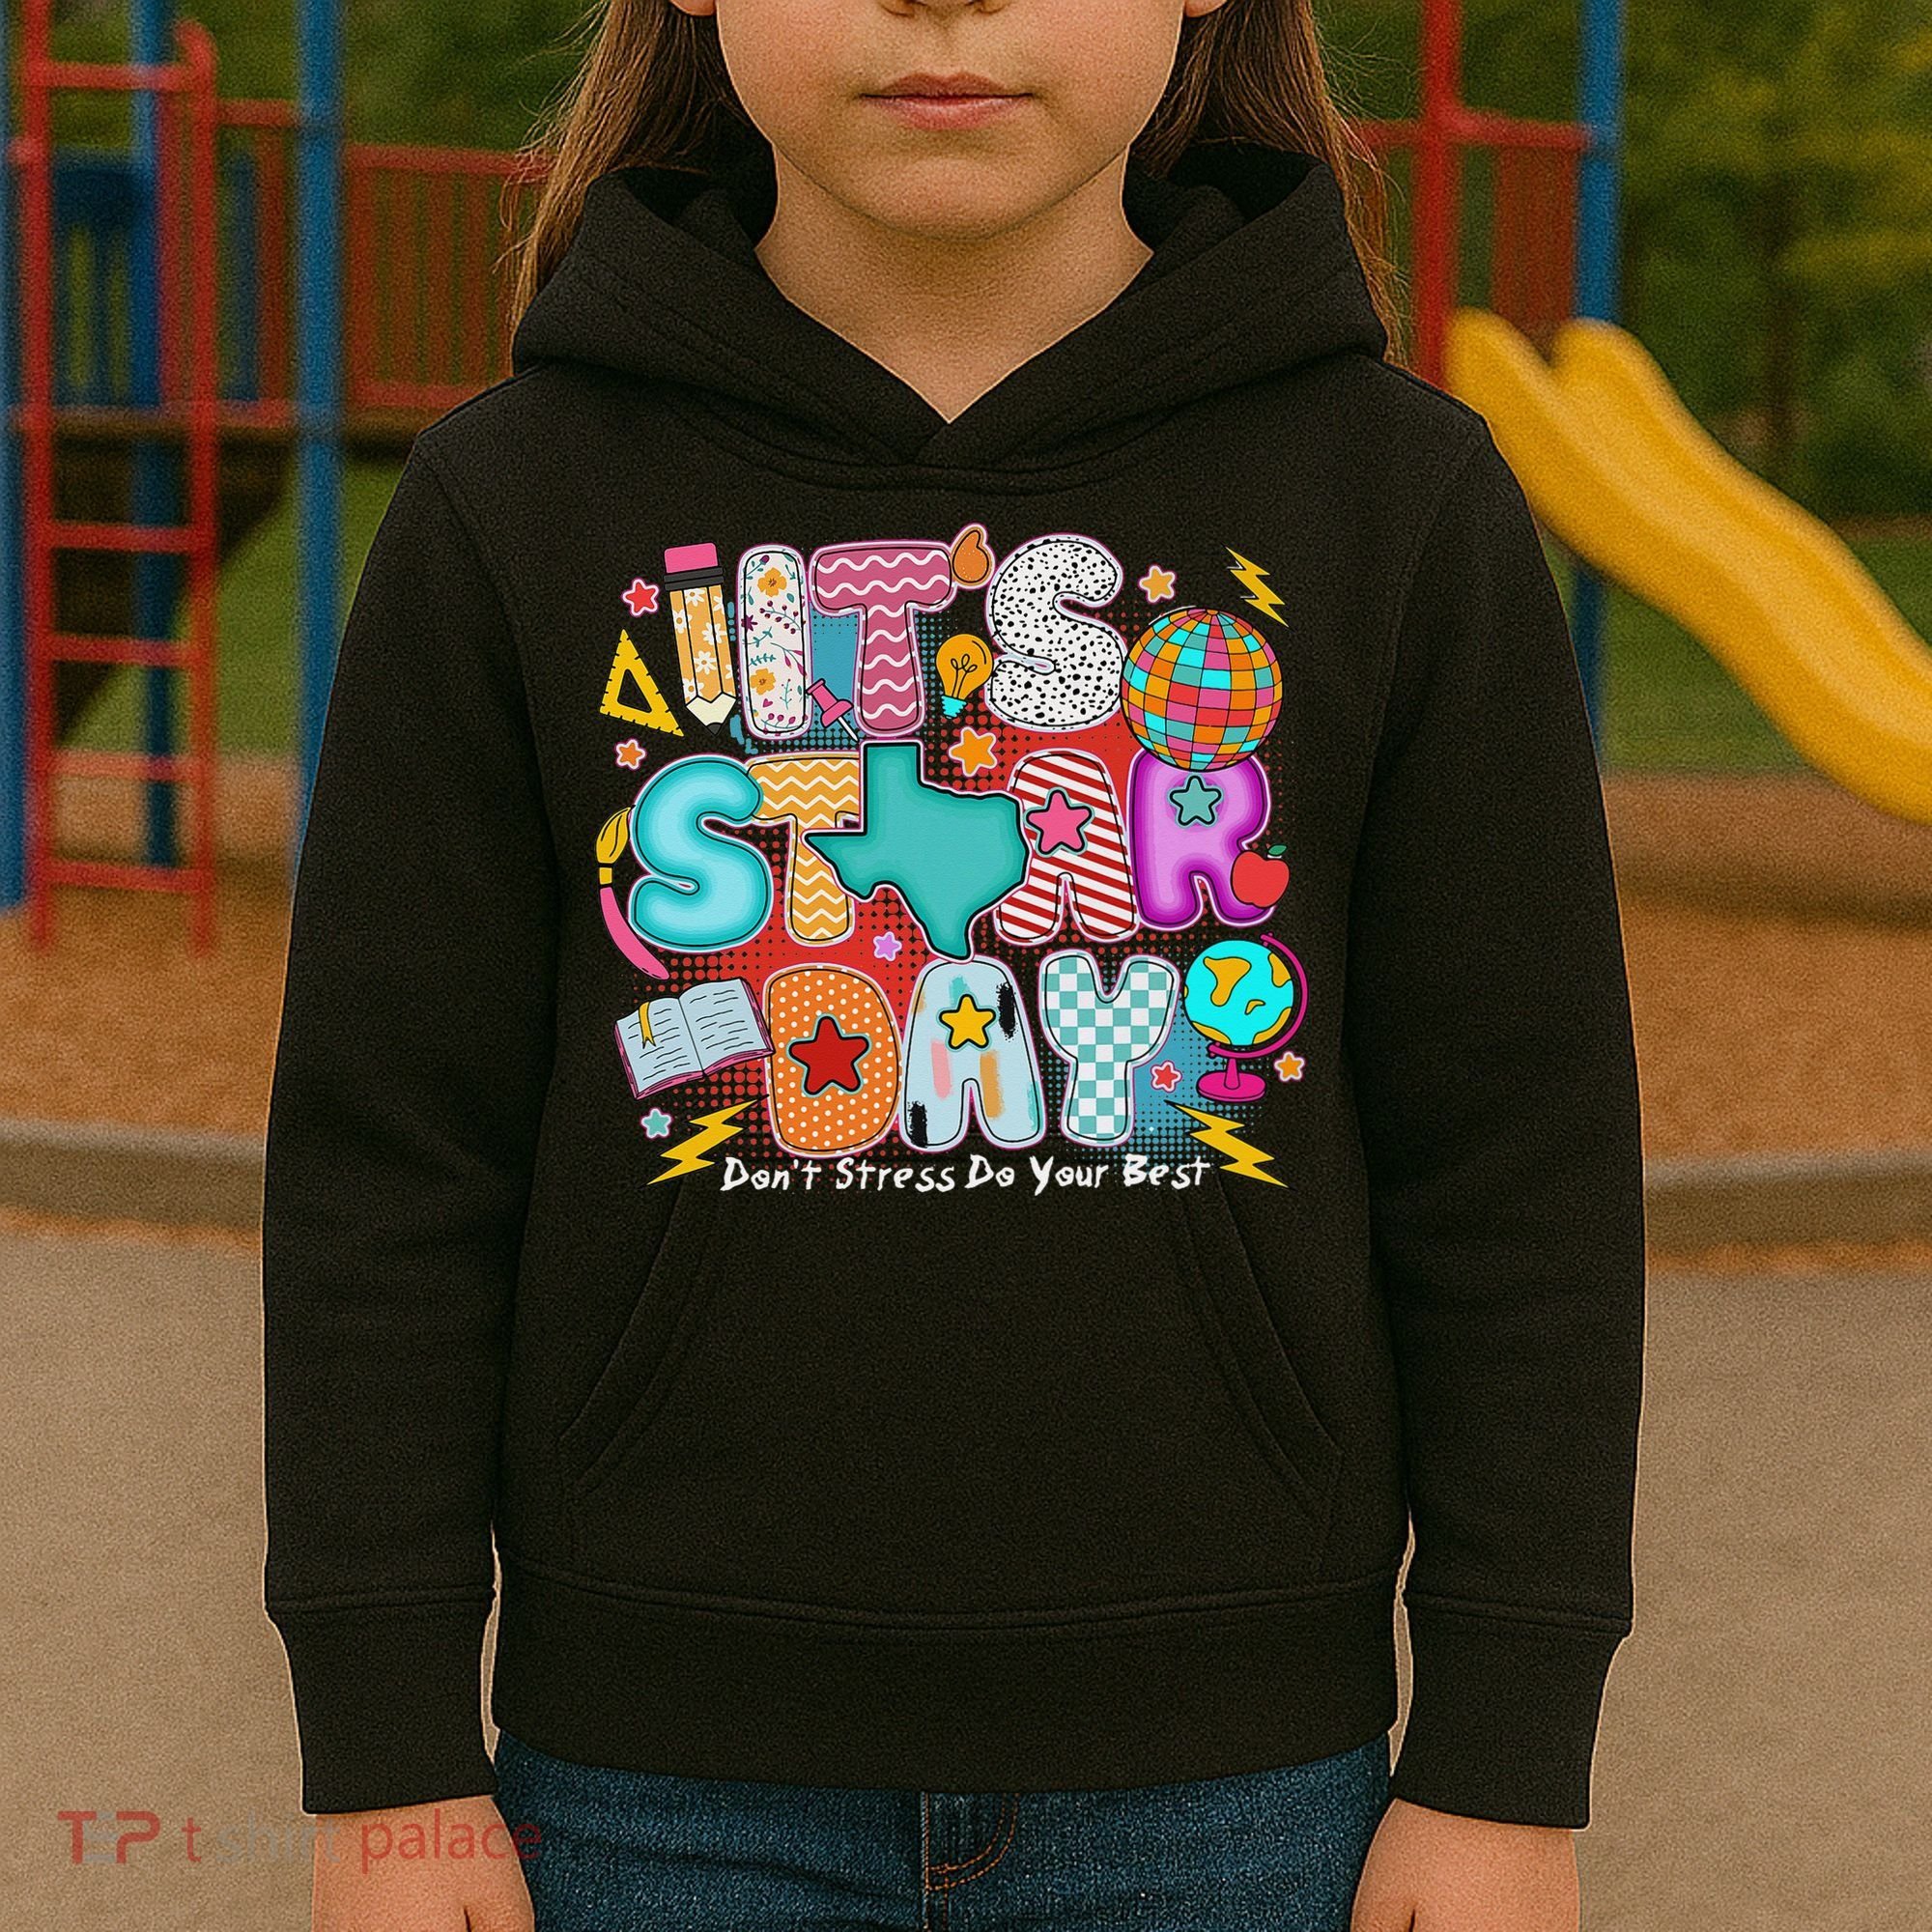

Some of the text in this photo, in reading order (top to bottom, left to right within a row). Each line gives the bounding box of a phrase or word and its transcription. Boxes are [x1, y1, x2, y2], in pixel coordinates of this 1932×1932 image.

[737, 525, 1128, 738] IT'S
[763, 950, 1180, 1157] DAY
[720, 1152, 1211, 1196] Don't Stress Do Your Best
